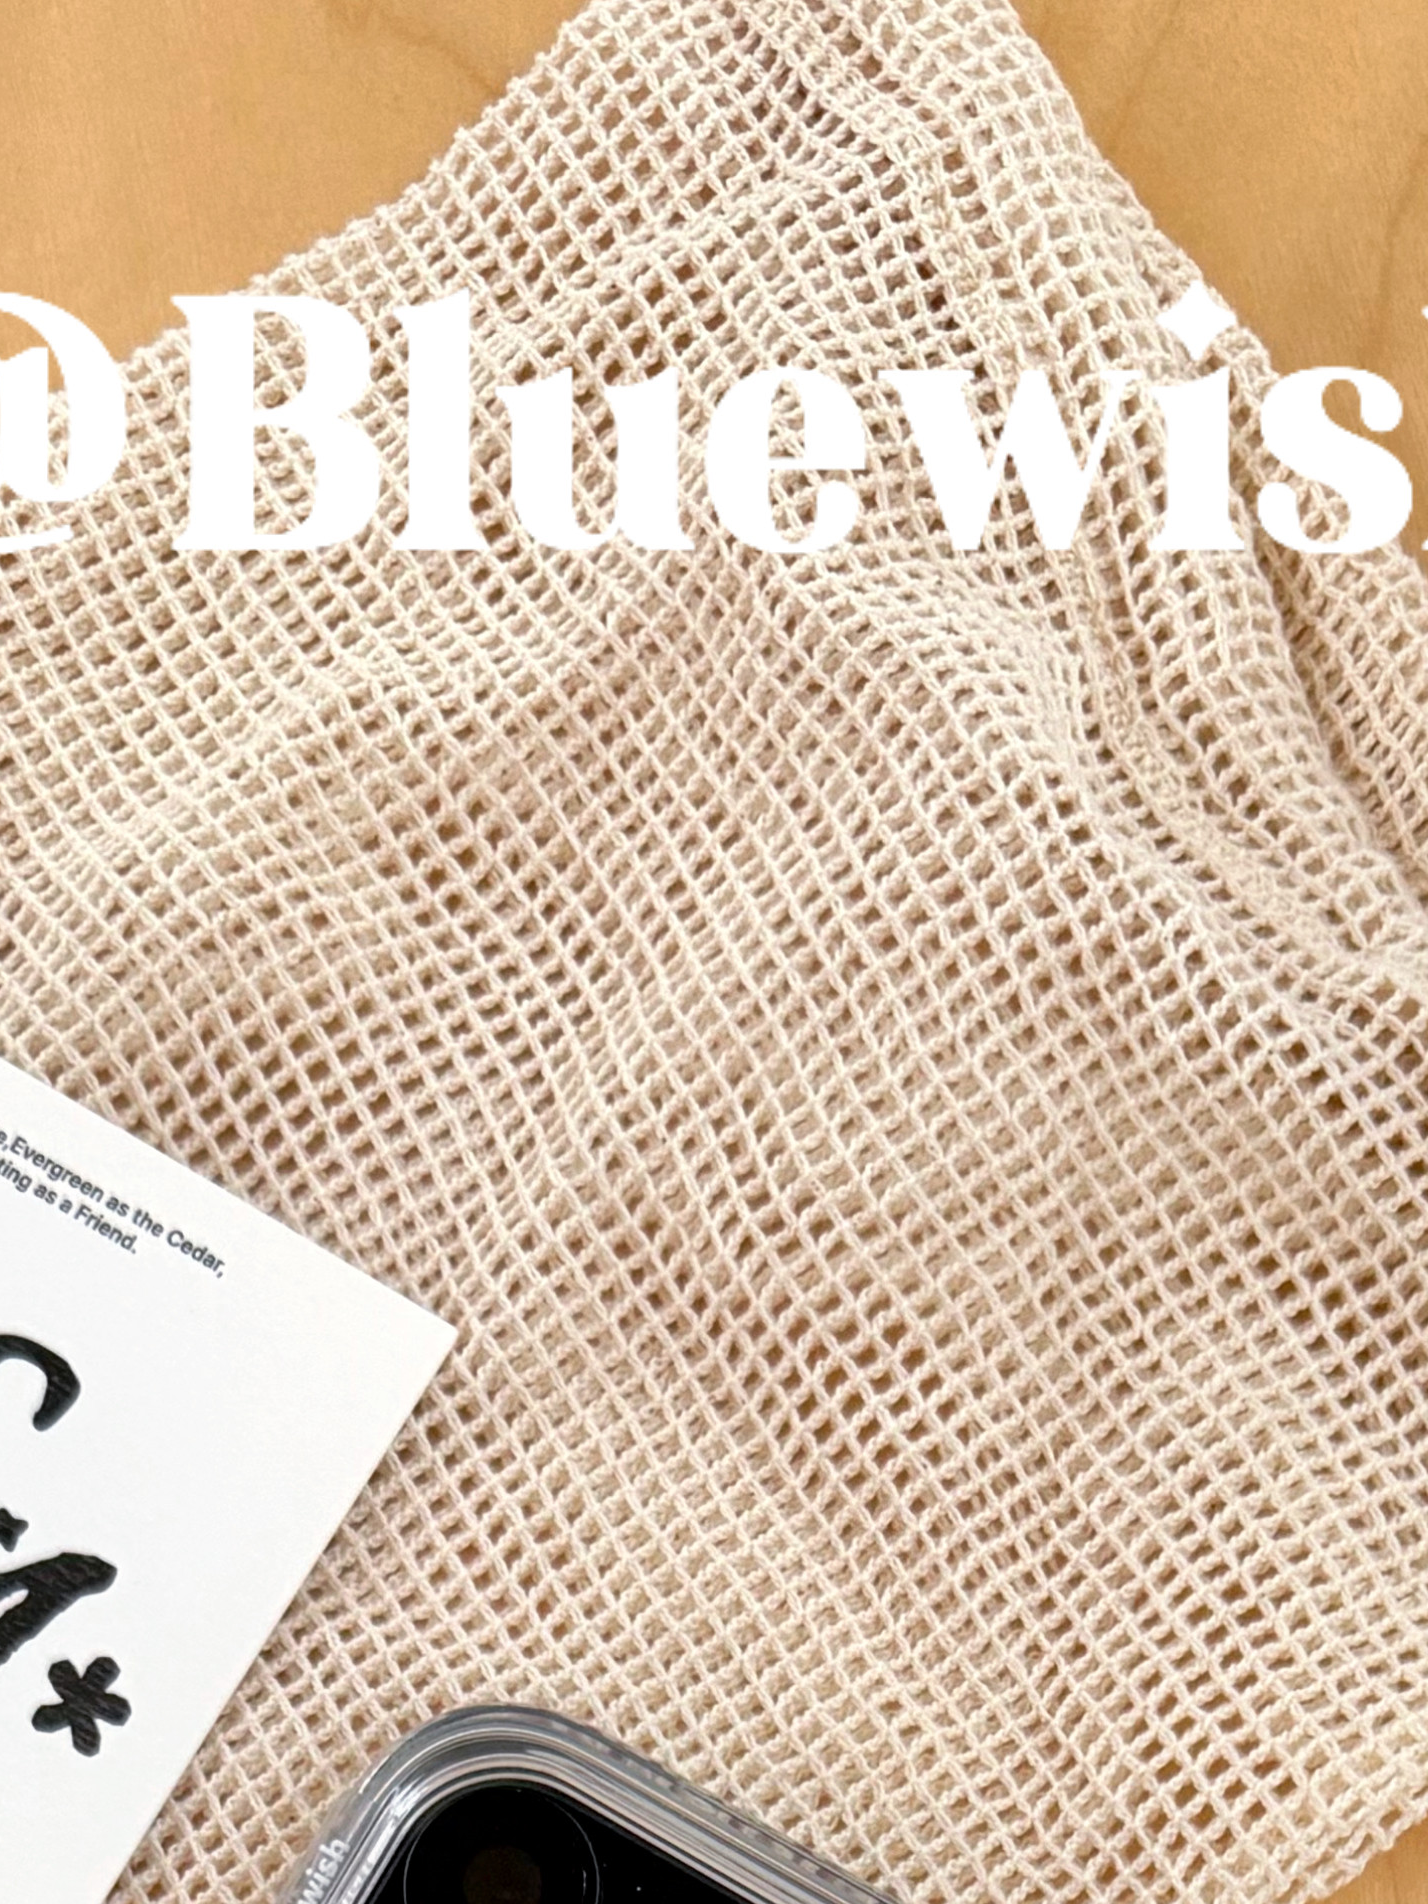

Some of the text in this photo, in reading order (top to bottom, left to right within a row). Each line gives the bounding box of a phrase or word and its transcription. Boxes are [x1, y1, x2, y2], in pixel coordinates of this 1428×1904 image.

[32, 1183, 59, 1206] as
[58, 1198, 74, 1215] a
[72, 1202, 138, 1255] Friend.
[104, 1196, 131, 1218] as
[130, 1207, 165, 1238] the
[165, 1229, 227, 1280] Cedar,
